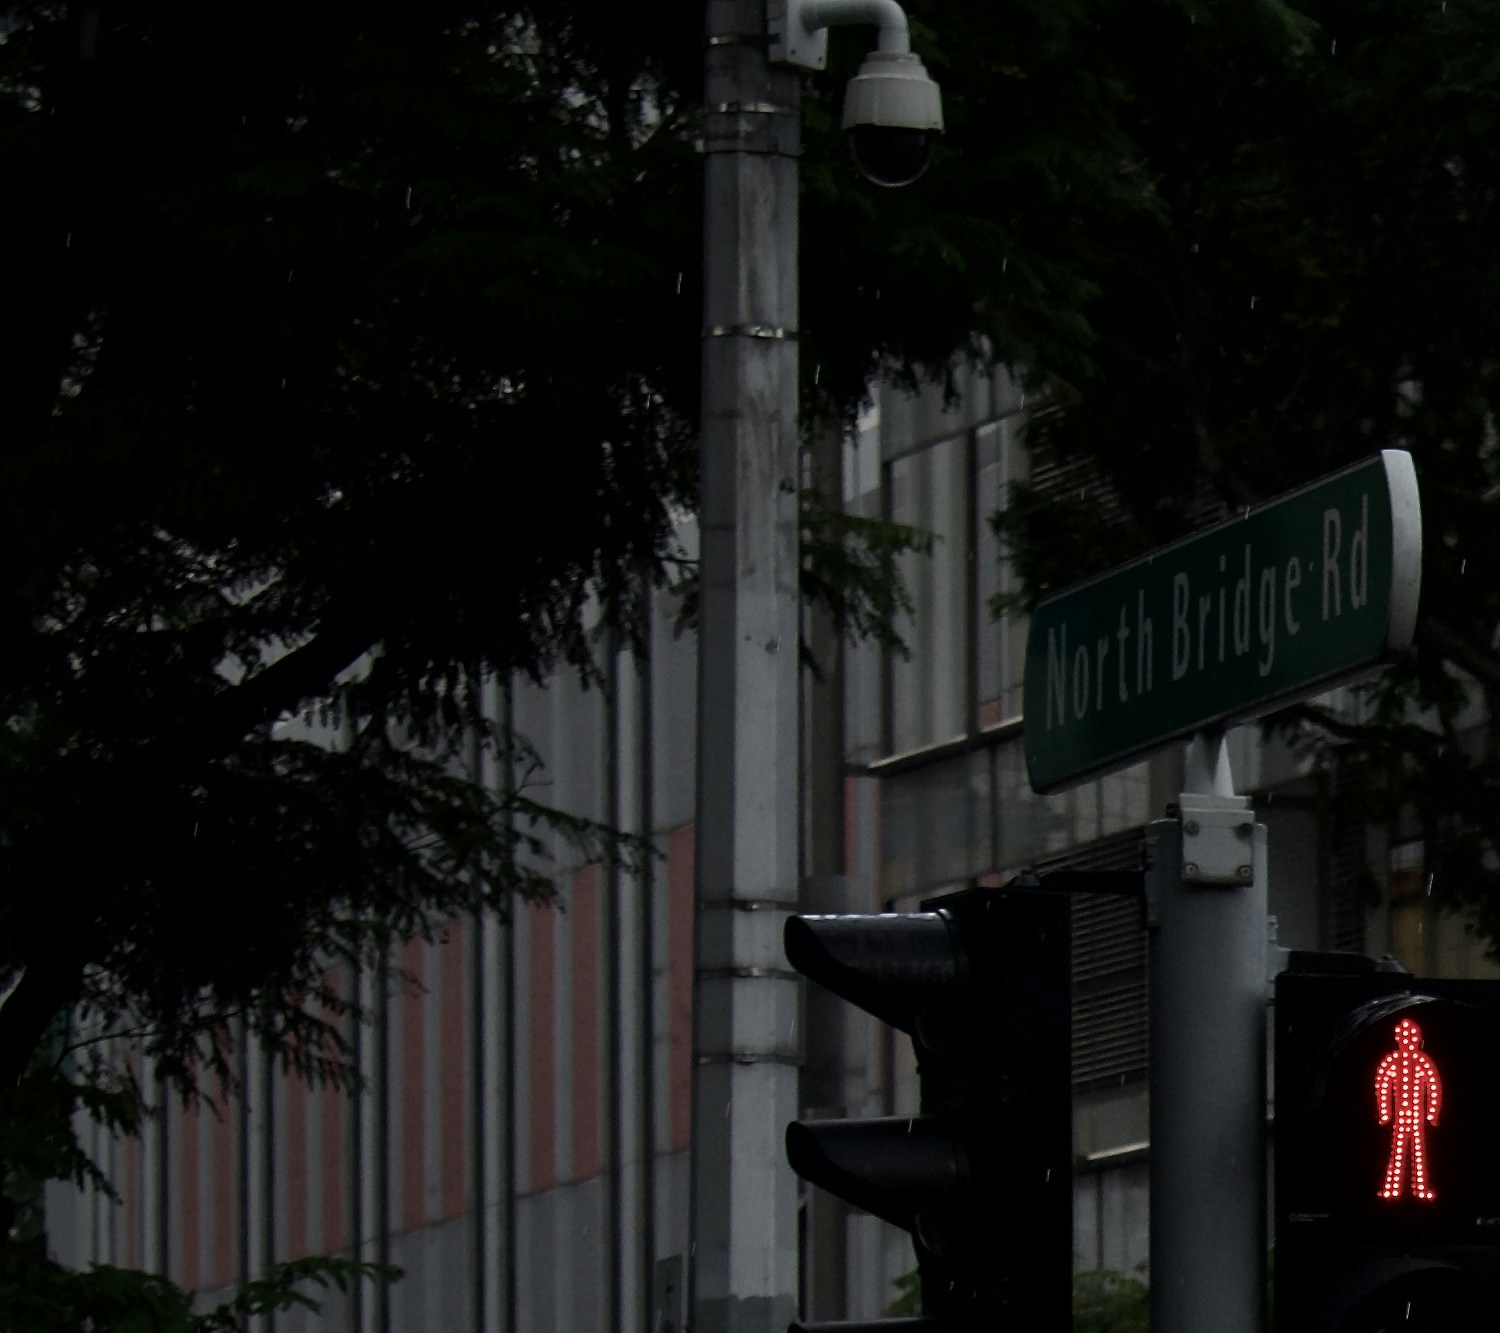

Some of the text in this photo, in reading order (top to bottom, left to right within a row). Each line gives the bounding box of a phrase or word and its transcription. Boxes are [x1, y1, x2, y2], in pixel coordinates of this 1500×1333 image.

[1046, 494, 1369, 731] North Bridge Rd
